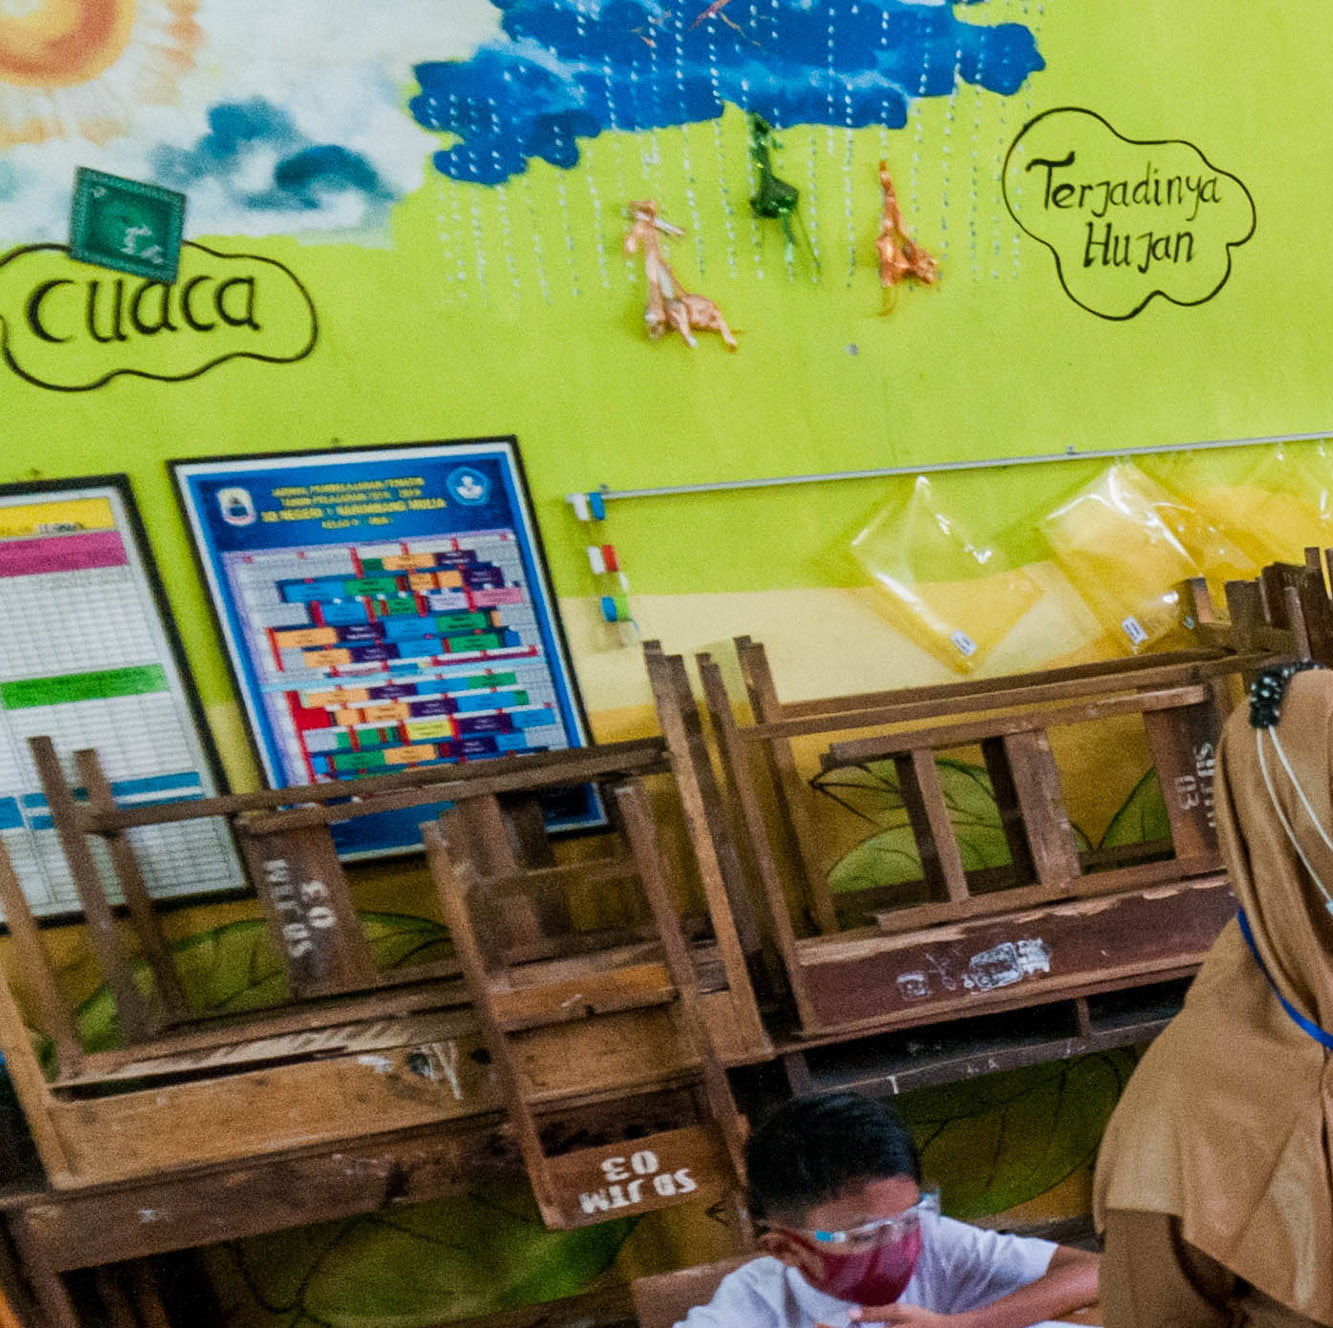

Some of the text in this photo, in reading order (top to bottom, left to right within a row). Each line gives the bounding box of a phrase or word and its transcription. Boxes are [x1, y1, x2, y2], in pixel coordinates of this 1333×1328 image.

[1083, 221, 1193, 273] Hujan
[600, 1150, 659, 1182] 03
[579, 1168, 698, 1214] SD JTM
